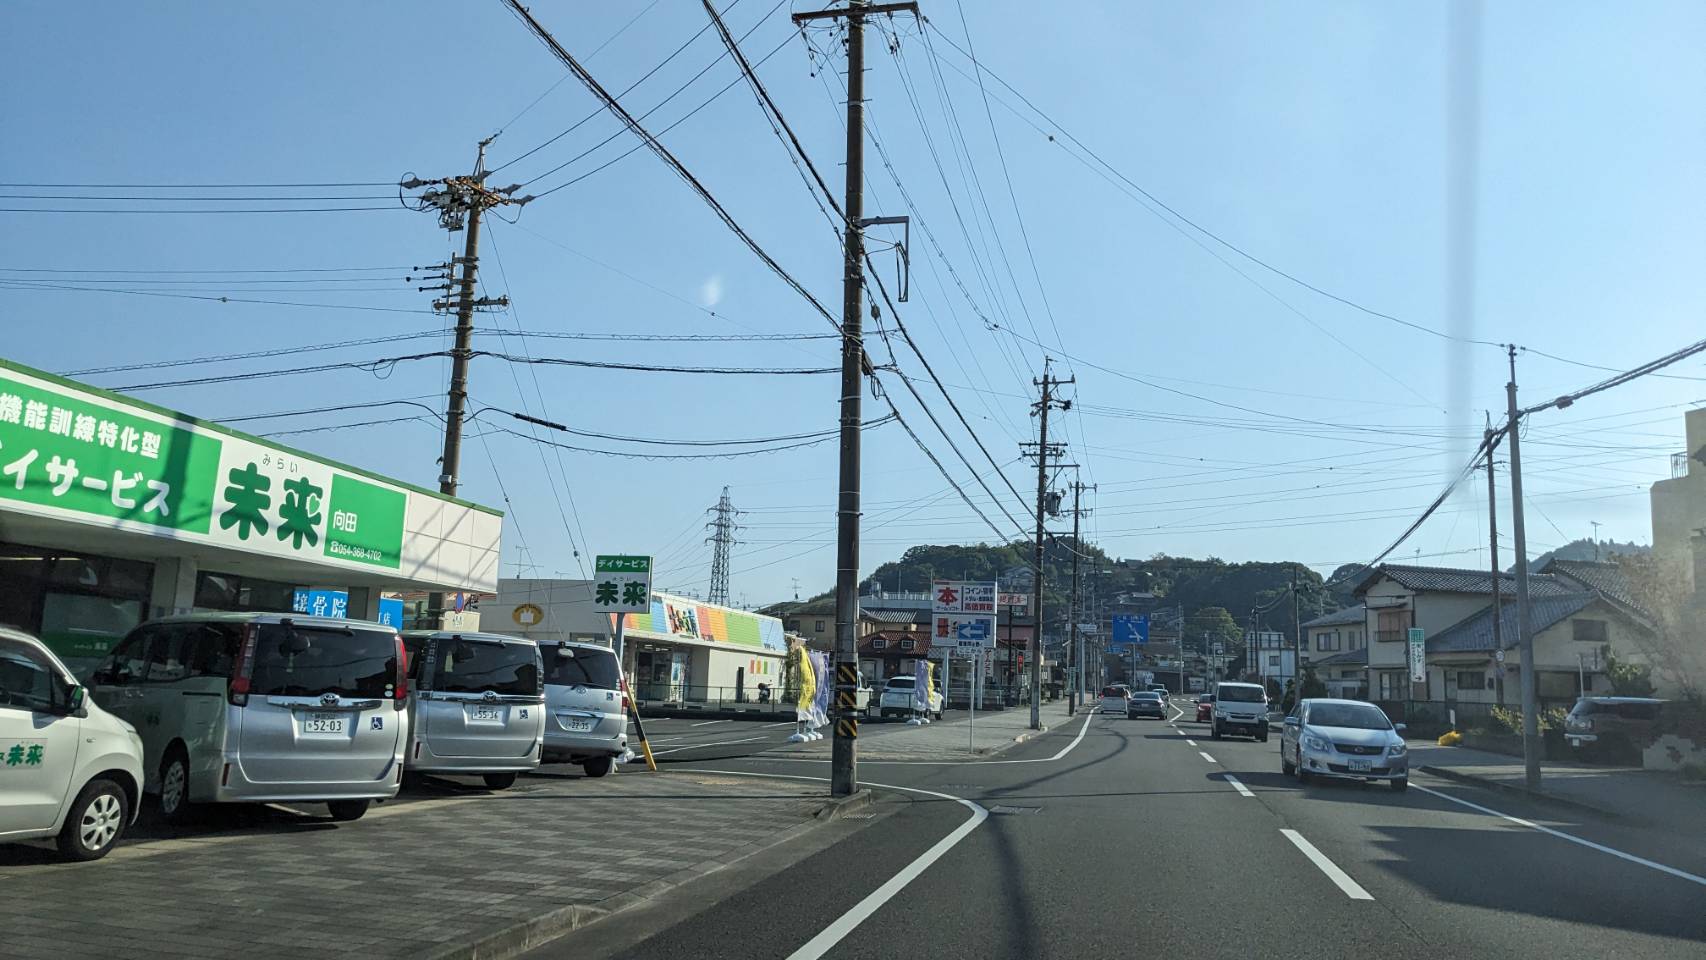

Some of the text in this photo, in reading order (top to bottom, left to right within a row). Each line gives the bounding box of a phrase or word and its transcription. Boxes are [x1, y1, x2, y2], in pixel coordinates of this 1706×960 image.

[0, 393, 161, 459] 機能訓練特化型
[262, 454, 298, 473] みらい
[0, 440, 170, 517] イサービス
[219, 462, 323, 550] 未来
[333, 509, 358, 533] 向田
[598, 559, 648, 568] デイサービス
[595, 581, 647, 606] 未来
[937, 587, 959, 606] 本
[6, 744, 44, 766] 未来
